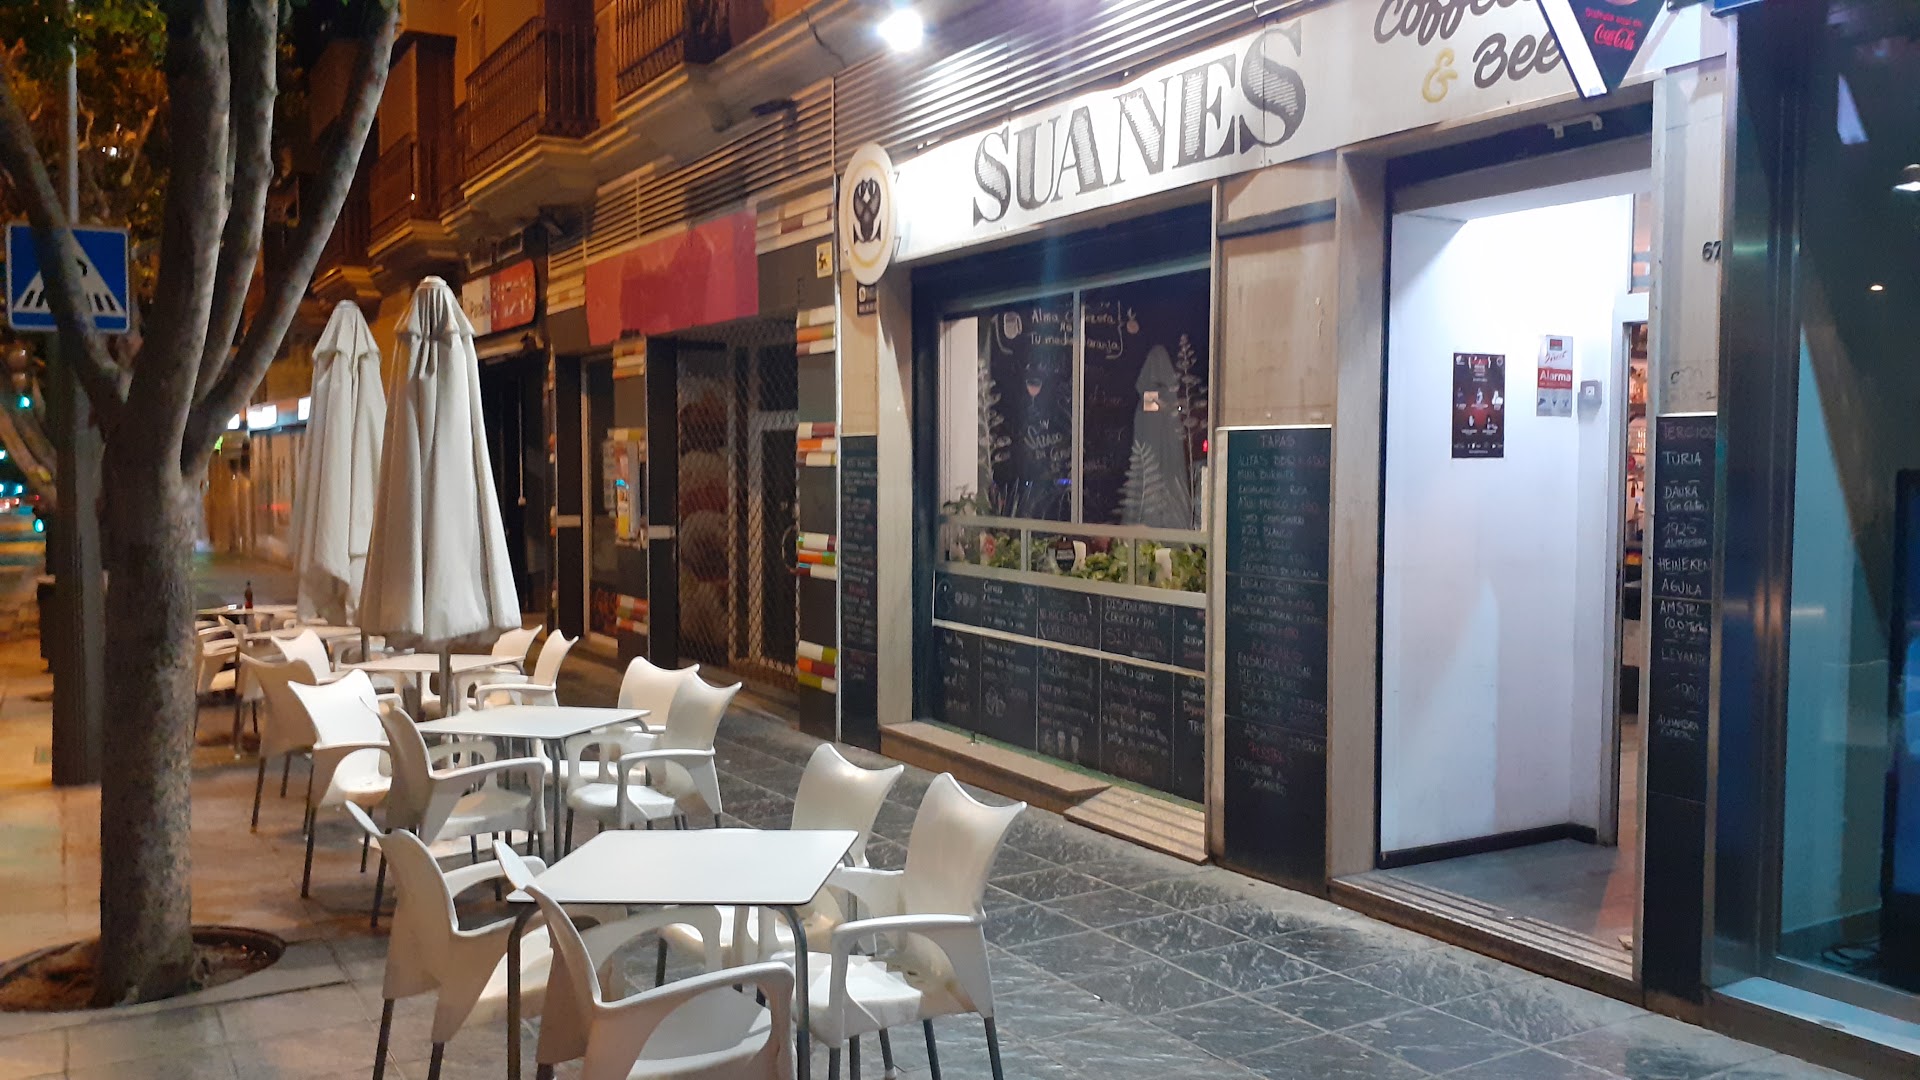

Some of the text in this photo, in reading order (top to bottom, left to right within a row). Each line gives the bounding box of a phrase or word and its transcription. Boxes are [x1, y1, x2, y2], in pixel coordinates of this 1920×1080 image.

[1374, 0, 1531, 46] Coff
[1422, 47, 1458, 102] &
[973, 20, 1306, 227] SUANES
[1702, 240, 1721, 263] 67
[1540, 369, 1571, 382] Alarma
[1660, 421, 1715, 440] TERCIOS
[1260, 434, 1296, 448] TAPAS
[1661, 451, 1702, 466] TURIA
[1663, 486, 1699, 499] DAURA
[1662, 522, 1697, 537] 1925
[1657, 556, 1713, 572] HEINEKEN
[1661, 578, 1703, 596] AGUILA
[1660, 600, 1704, 617] AMSTEL
